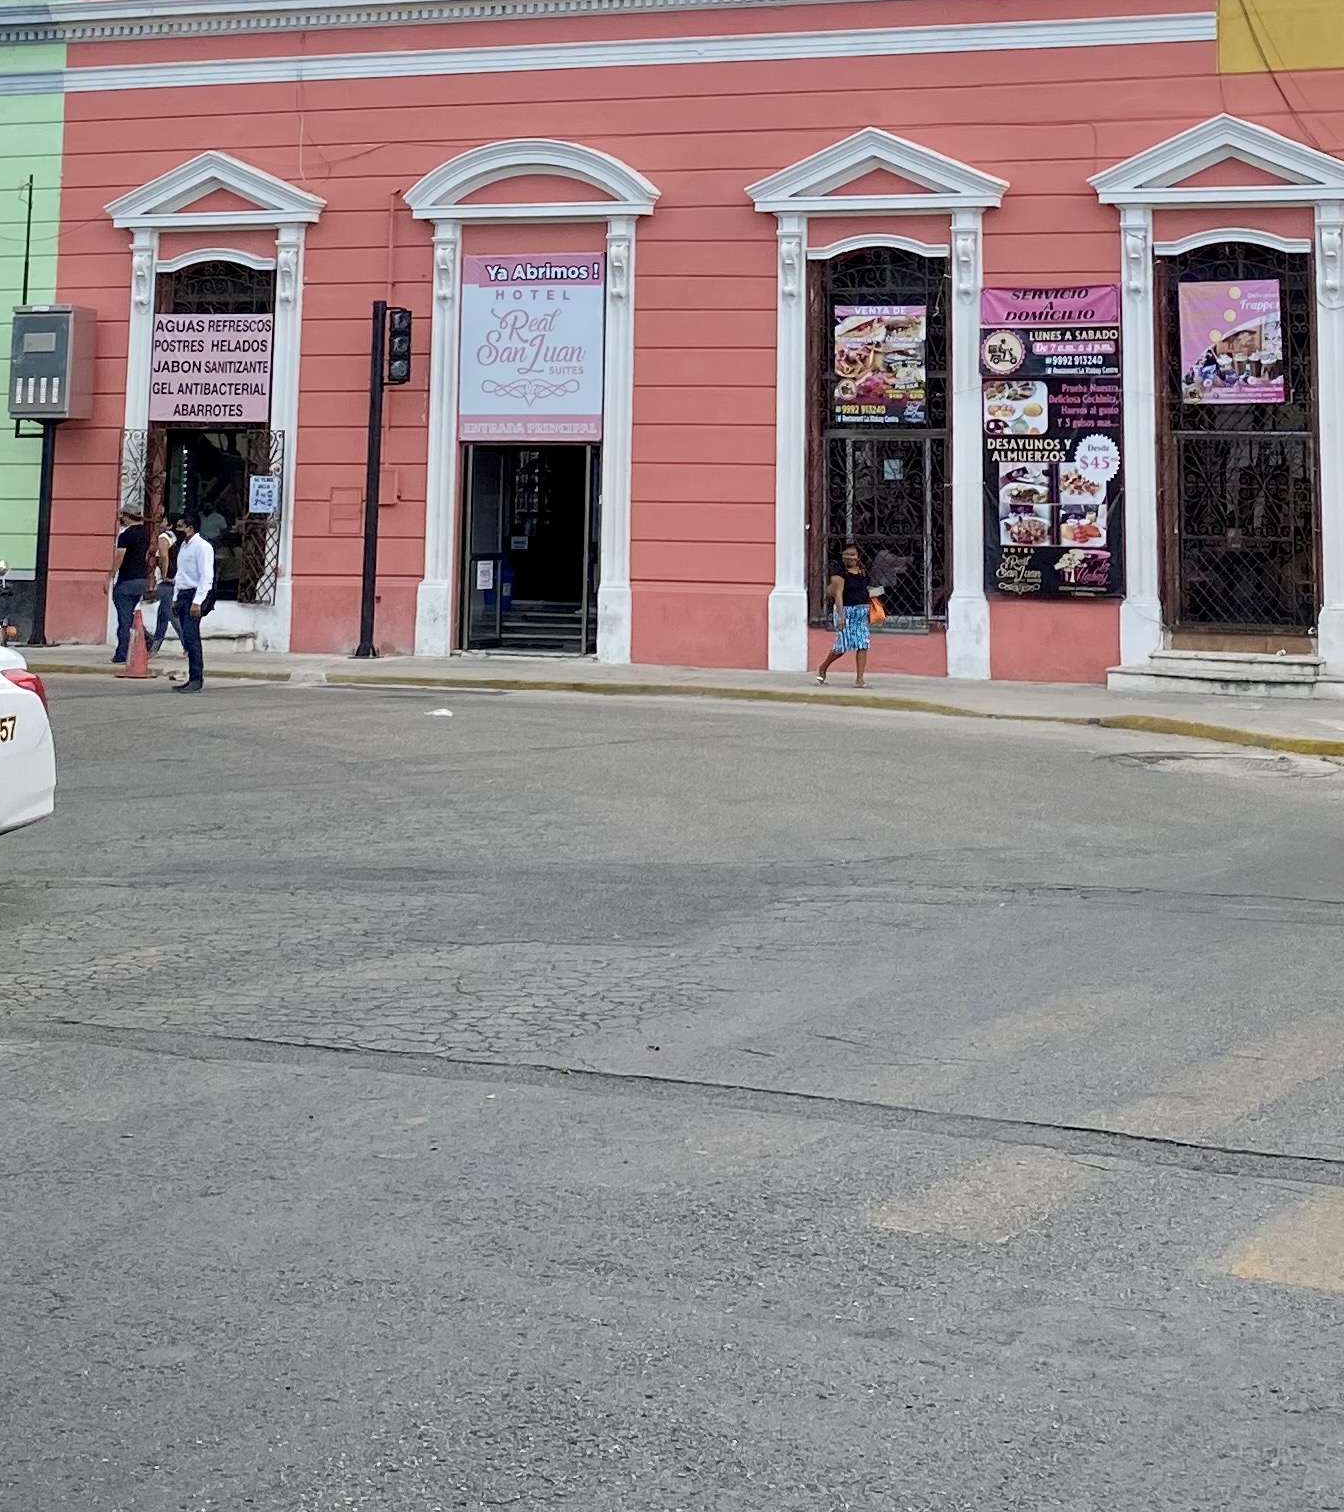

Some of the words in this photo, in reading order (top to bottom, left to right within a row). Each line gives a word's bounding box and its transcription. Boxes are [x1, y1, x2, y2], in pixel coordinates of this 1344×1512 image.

[486, 264, 508, 280] Ya
[512, 263, 588, 280] Abrimos
[495, 290, 570, 300] HOTEL
[1011, 289, 1088, 300] SERVICIO
[855, 307, 889, 315] VENTA
[893, 307, 907, 315] DE
[1043, 302, 1054, 310] A
[1004, 310, 1095, 321] DOMICILIO
[155, 320, 205, 332] AGUAS
[208, 320, 272, 332] REFRESCOS
[491, 309, 562, 343] Real
[1029, 331, 1061, 341] LUNES
[1064, 331, 1073, 340] A
[1076, 330, 1118, 340] SABADO
[154, 340, 204, 352] POSTRES
[211, 340, 268, 352] HELADOS
[477, 330, 528, 366] San
[517, 334, 587, 374] Juan
[153, 361, 202, 373] JABON
[204, 361, 269, 373] SANITIZANTE
[548, 366, 584, 375] SUITES
[152, 382, 174, 395] GEL
[177, 383, 266, 395] ANTIBACTERIAL
[173, 404, 243, 417] ABARROTES
[463, 423, 524, 434] ENTRADA
[526, 422, 597, 434] PRINCIPAL
[987, 438, 1060, 450] DESAYUNOS
[1063, 438, 1072, 449] Y
[992, 450, 1066, 462] ALMUERZOS
